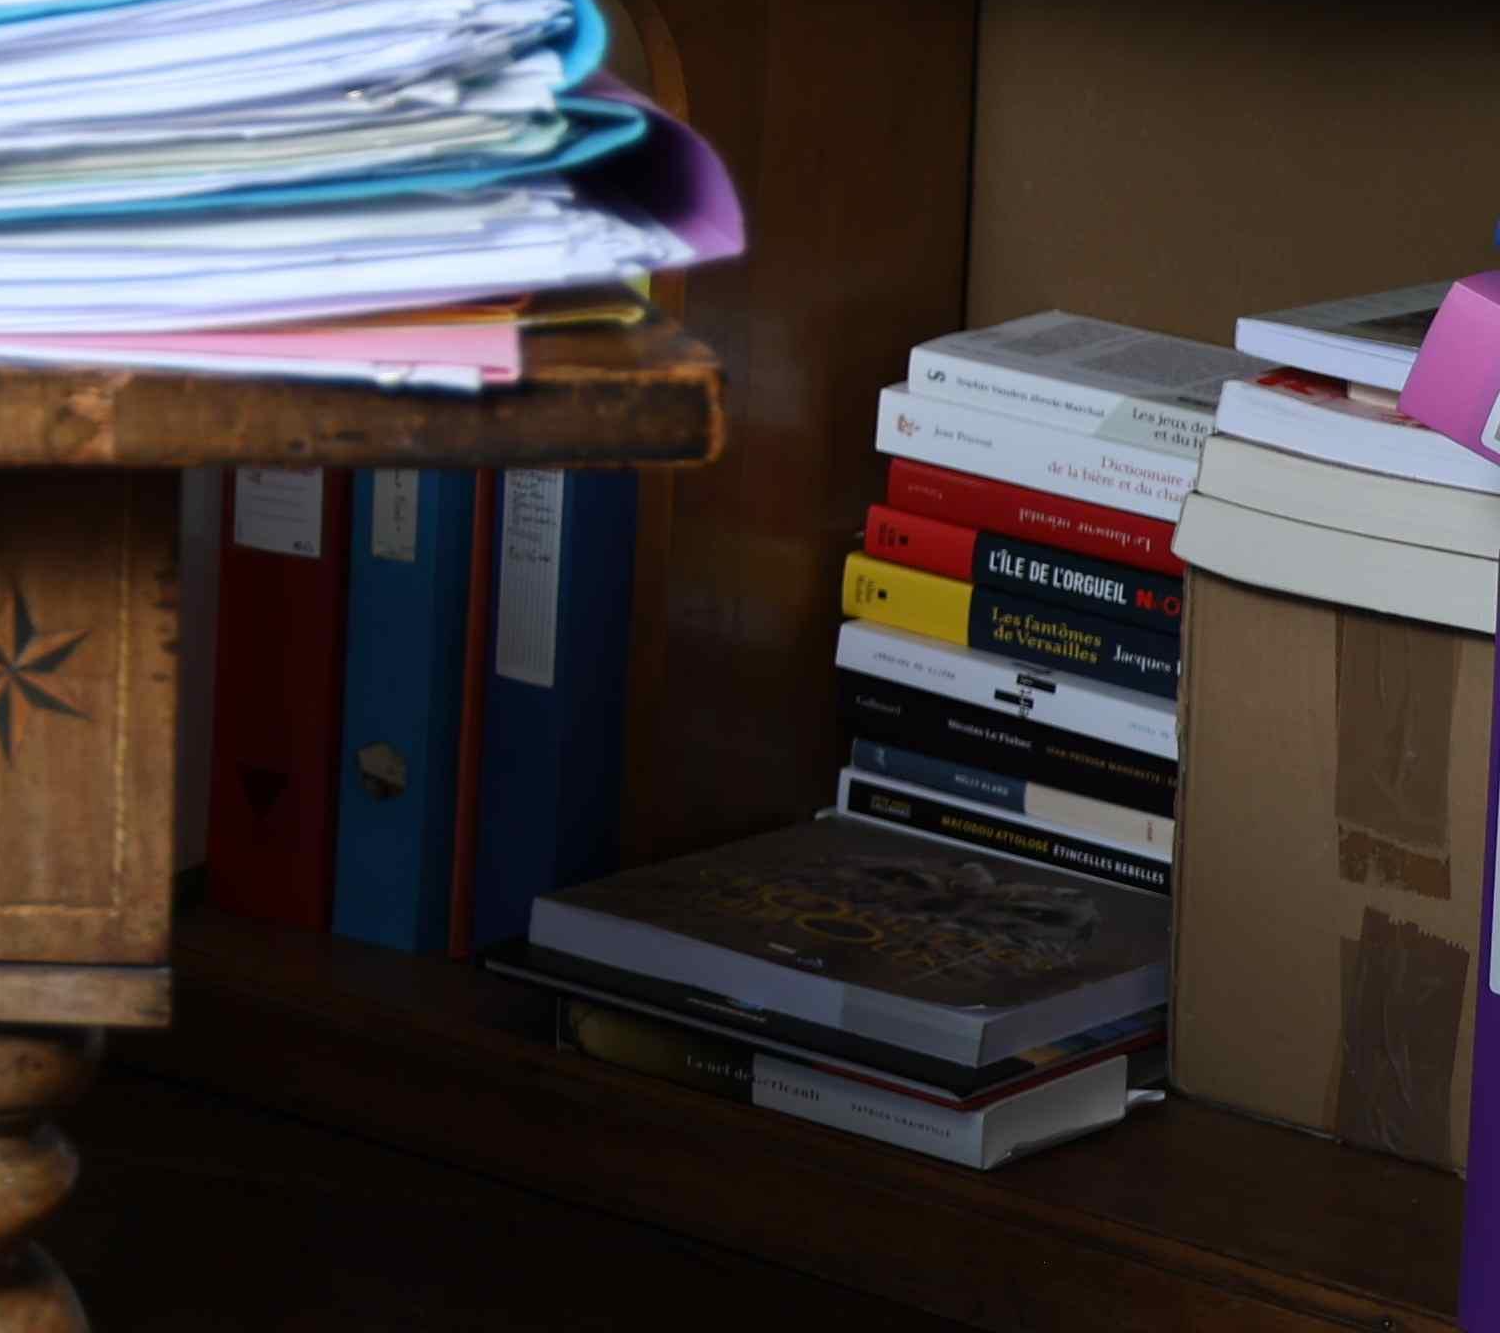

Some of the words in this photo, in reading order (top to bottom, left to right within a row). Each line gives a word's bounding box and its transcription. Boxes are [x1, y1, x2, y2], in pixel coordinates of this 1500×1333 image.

[1131, 405, 1155, 424] Les
[1157, 410, 1188, 436] jeux
[1189, 420, 1209, 435] de
[1153, 430, 1168, 442] et
[1168, 431, 1190, 448] du
[1046, 460, 1063, 474] de
[1067, 463, 1081, 477] la
[1081, 466, 1115, 489] bière
[1117, 477, 1132, 491] et
[1133, 480, 1153, 496] du
[1100, 455, 1185, 487] Dictionnaire
[988, 547, 1025, 580] L'ÎLE
[1028, 559, 1051, 585] DE
[1052, 564, 1128, 606] L'ORGUEIL
[991, 606, 1022, 626] Les
[1024, 615, 1103, 648] fantômes
[992, 627, 1015, 643] de
[1016, 631, 1099, 665] Versailles
[1112, 643, 1172, 676] Jacques
[1053, 842, 1115, 874] ÉTINCELLES
[1114, 859, 1166, 887] REBELLES
